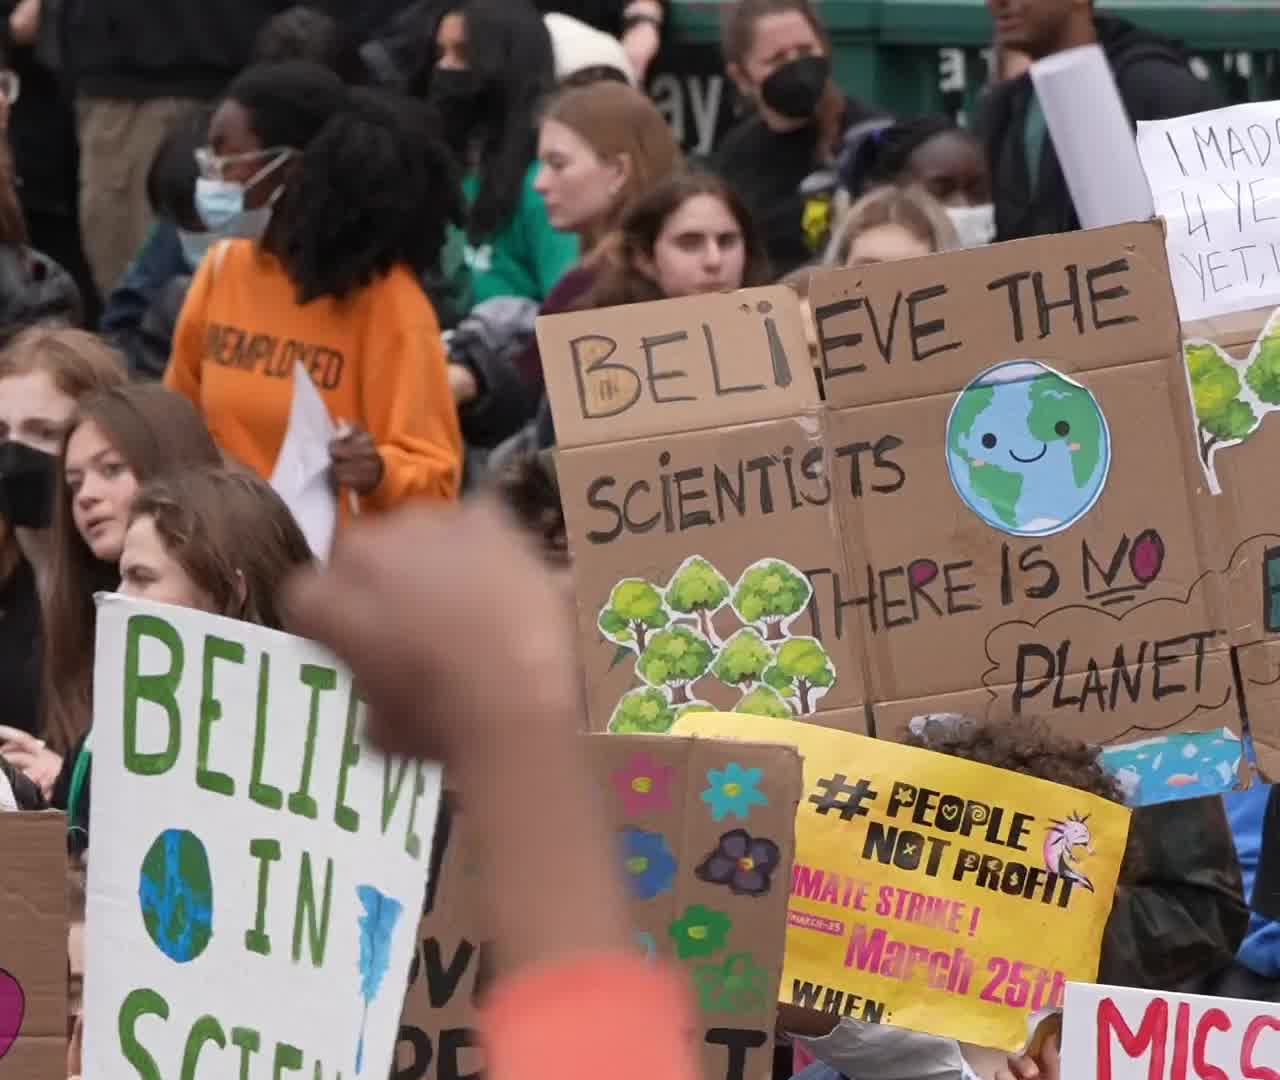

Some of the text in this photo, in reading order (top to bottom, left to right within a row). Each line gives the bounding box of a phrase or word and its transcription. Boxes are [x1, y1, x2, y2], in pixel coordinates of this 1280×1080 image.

[1192, 118, 1280, 171] MAD
[1181, 191, 1210, 242] 4
[1180, 244, 1265, 302] YET,
[569, 258, 1138, 420] BELIEVE THE
[585, 435, 906, 545] SCIENTISTS
[804, 528, 1165, 640] THERE IS NO
[1013, 629, 1226, 713] PLANET
[245, 838, 335, 969] IN
[861, 822, 1075, 908] NOT PROFIT
[844, 923, 973, 994] March
[792, 979, 892, 1023] WHEN:
